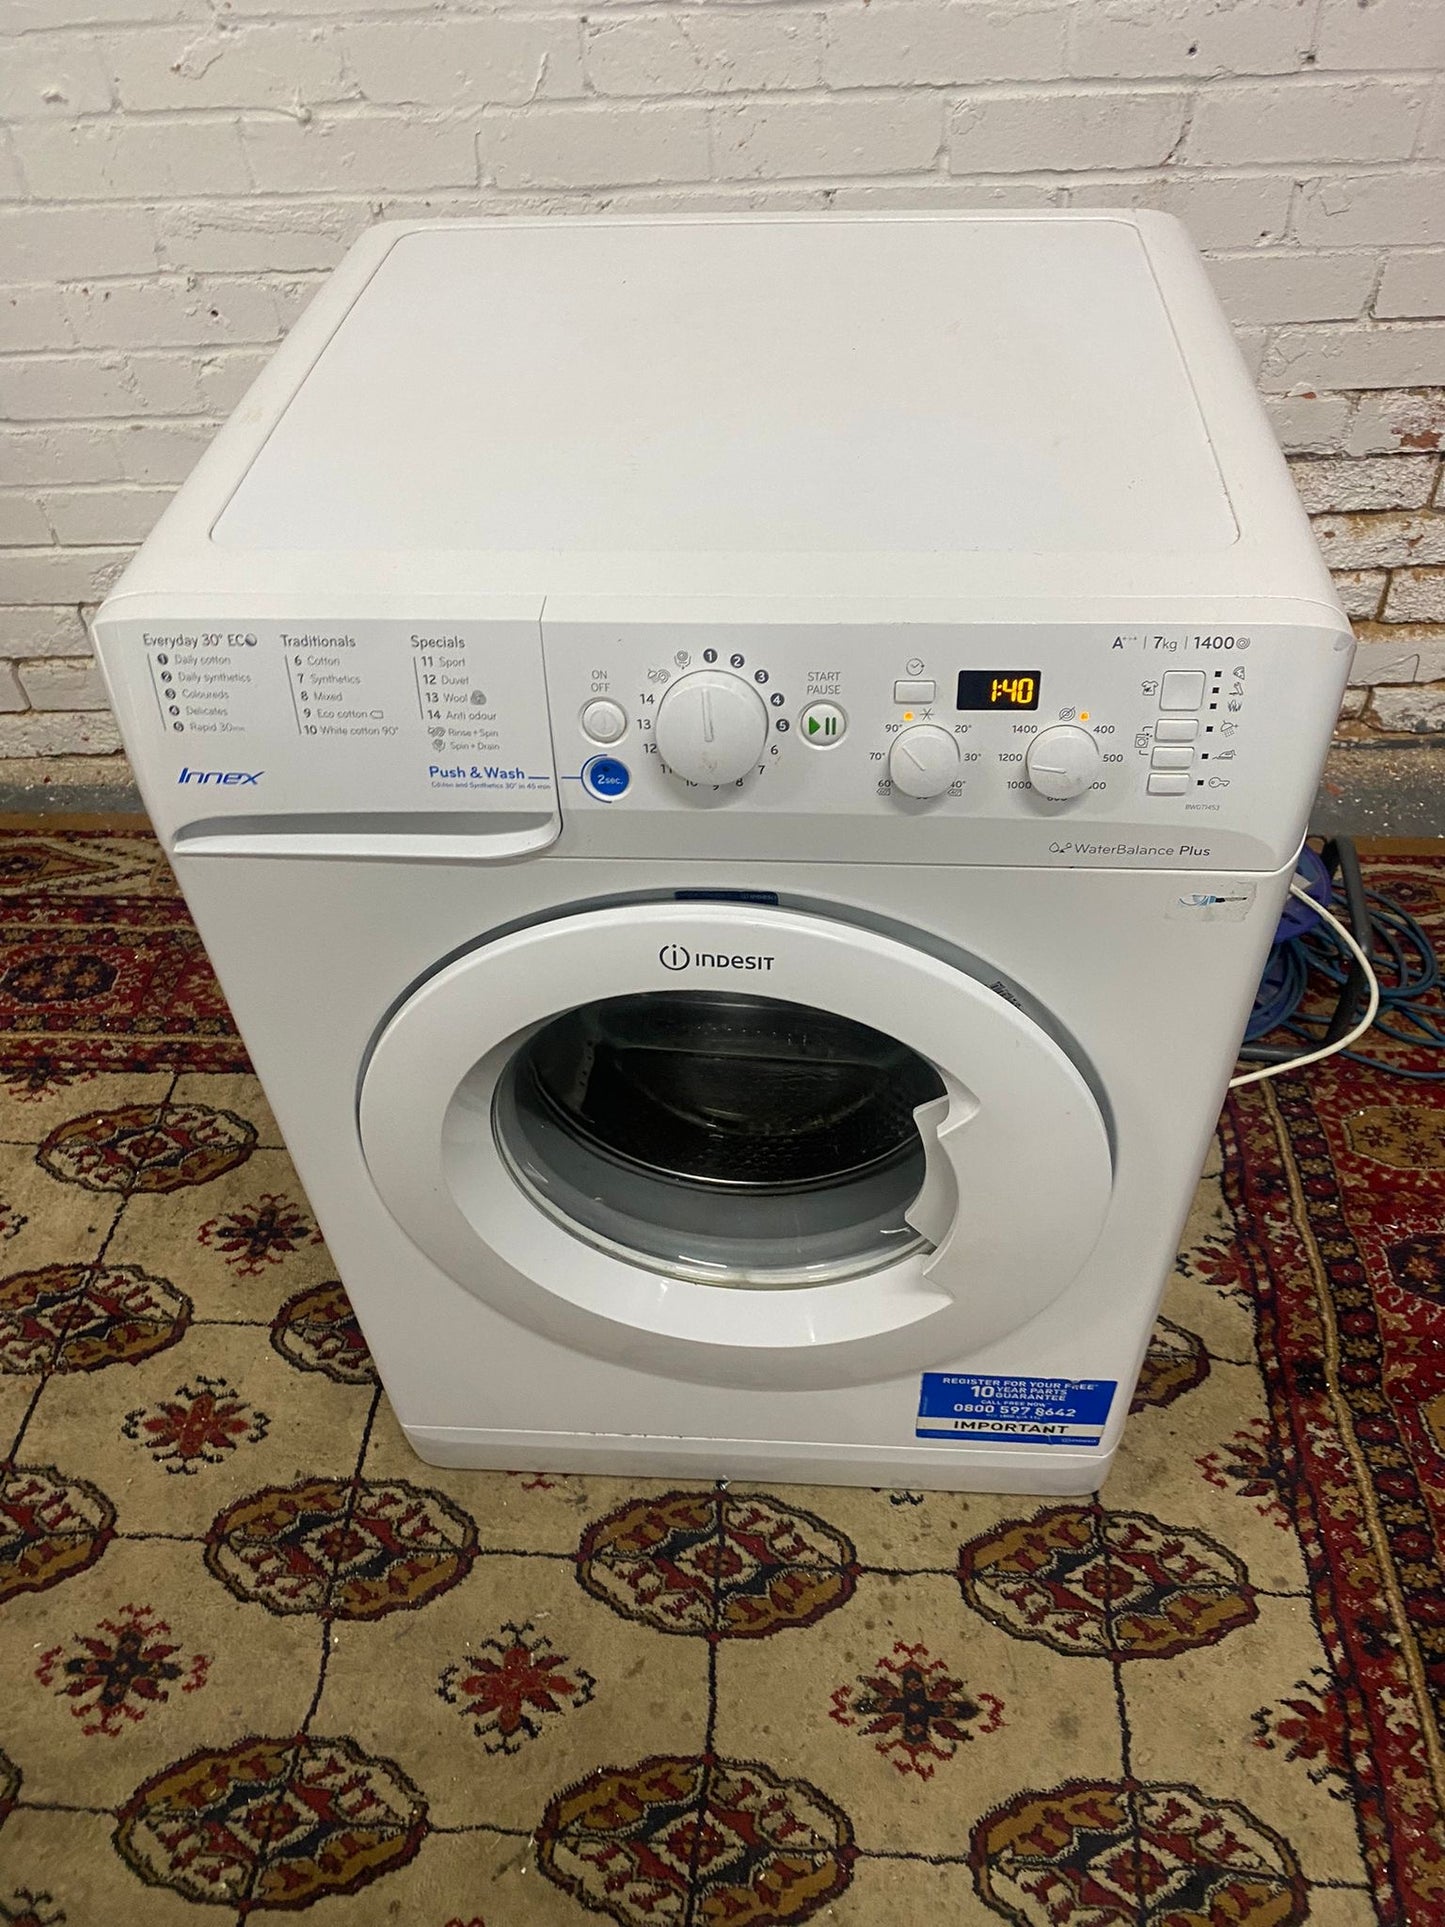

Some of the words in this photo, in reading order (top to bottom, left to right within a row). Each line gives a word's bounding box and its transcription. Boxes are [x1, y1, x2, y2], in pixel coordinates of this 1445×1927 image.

[143, 633, 198, 649] Everyday
[280, 634, 356, 647] Traditionals
[410, 634, 466, 650] Specials
[1154, 636, 1178, 652] 7kg
[1194, 636, 1234, 650] 1400
[175, 654, 198, 666] Daily
[200, 656, 231, 665] cotton
[294, 655, 302, 666] 6
[307, 655, 340, 666] Cotton
[421, 656, 434, 667] 11
[439, 656, 466, 668] Sport
[178, 672, 200, 684] Daily
[204, 673, 252, 684] synthetics
[297, 673, 304, 684] 7
[310, 674, 362, 684] Synthetics
[423, 674, 437, 685] 12
[441, 674, 469, 685] Duvet
[592, 670, 608, 680] ON
[807, 672, 841, 682] START
[591, 683, 610, 692] OFF
[806, 685, 841, 695] PAUSE
[990, 678, 1034, 703] 1:40
[301, 690, 309, 701] 8
[425, 692, 439, 702] 13
[443, 693, 468, 702] Wool
[640, 694, 654, 704] 14
[304, 708, 311, 718] 9
[317, 709, 334, 718] Eco
[337, 710, 368, 718] cotton
[428, 710, 441, 720] 14
[637, 719, 651, 730] 13
[1012, 725, 1038, 734] 1400
[1094, 725, 1115, 734] 400
[304, 725, 318, 735] 10
[350, 727, 380, 735] cotton
[644, 744, 657, 754] 12
[770, 744, 778, 754] 6
[998, 753, 1022, 762] 1200
[1103, 754, 1124, 762] 500
[429, 766, 466, 778] Push
[470, 766, 482, 778] &
[484, 767, 524, 779] Wash
[758, 764, 766, 774] 7
[178, 767, 265, 785] Innex
[736, 778, 744, 786] 8
[1007, 781, 1032, 789] 1000
[1088, 782, 1106, 790] 00
[1075, 844, 1174, 856] WaterBalance
[1179, 846, 1210, 856] Plus
[943, 1378, 1000, 1387] REGISTER
[1004, 1380, 1026, 1388] FOR
[1030, 1381, 1061, 1390] YOUR
[970, 1386, 994, 1398] 10
[996, 1386, 1027, 1394] YEAR
[1030, 1388, 1068, 1396] PARTS
[996, 1392, 1066, 1401] GUARANTEE
[954, 1404, 994, 1414] 0800
[1000, 1405, 1030, 1415] 597
[1035, 1408, 1076, 1418] 8642
[954, 1421, 1068, 1434] IMPORTANT
